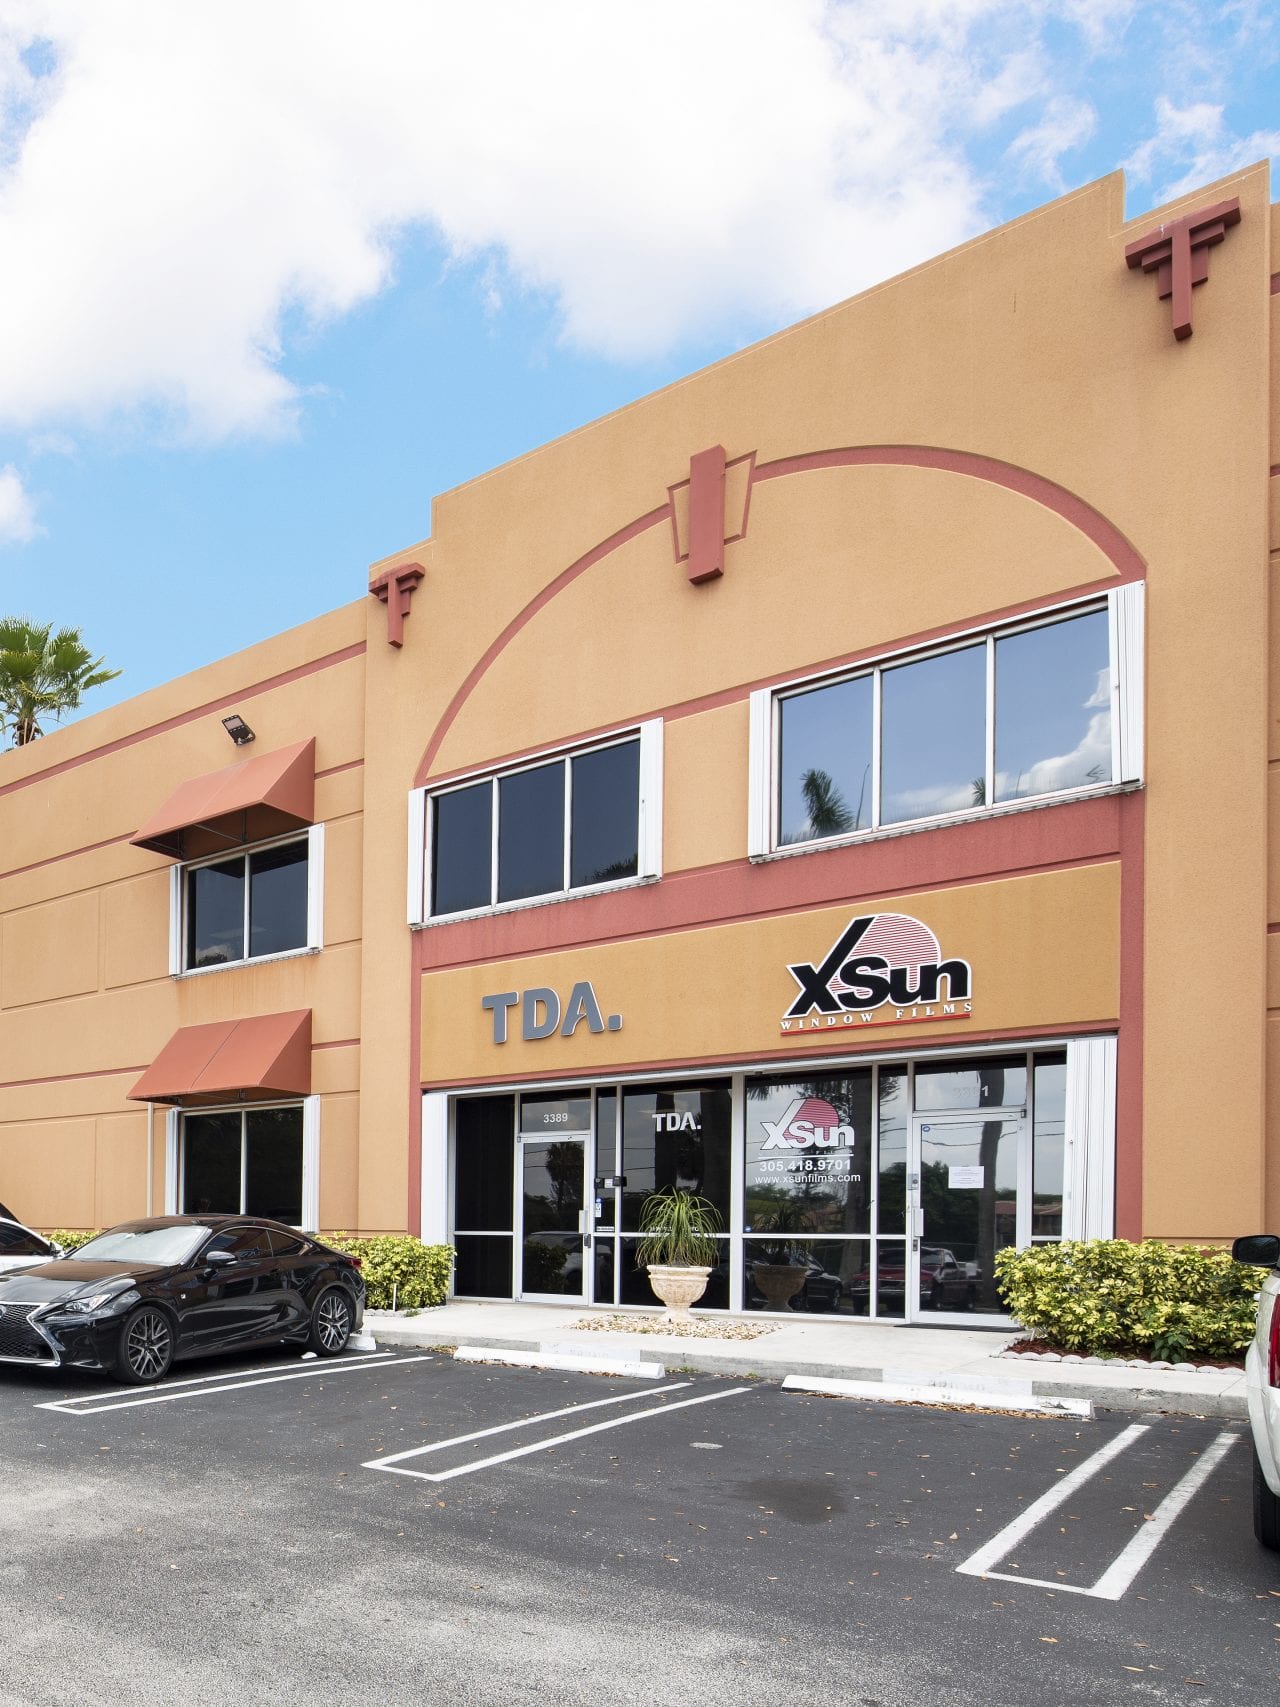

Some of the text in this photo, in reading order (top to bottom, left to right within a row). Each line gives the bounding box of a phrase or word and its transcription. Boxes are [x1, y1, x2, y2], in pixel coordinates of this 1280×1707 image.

[482, 981, 623, 1044] TDA.
[780, 1002, 972, 1031] WINDOW FILMS
[543, 1112, 568, 1123] 3389
[651, 1111, 702, 1132] TDA.
[760, 1159, 851, 1172] 305.418.9701
[755, 1173, 861, 1184] www.xsunfilms.com
